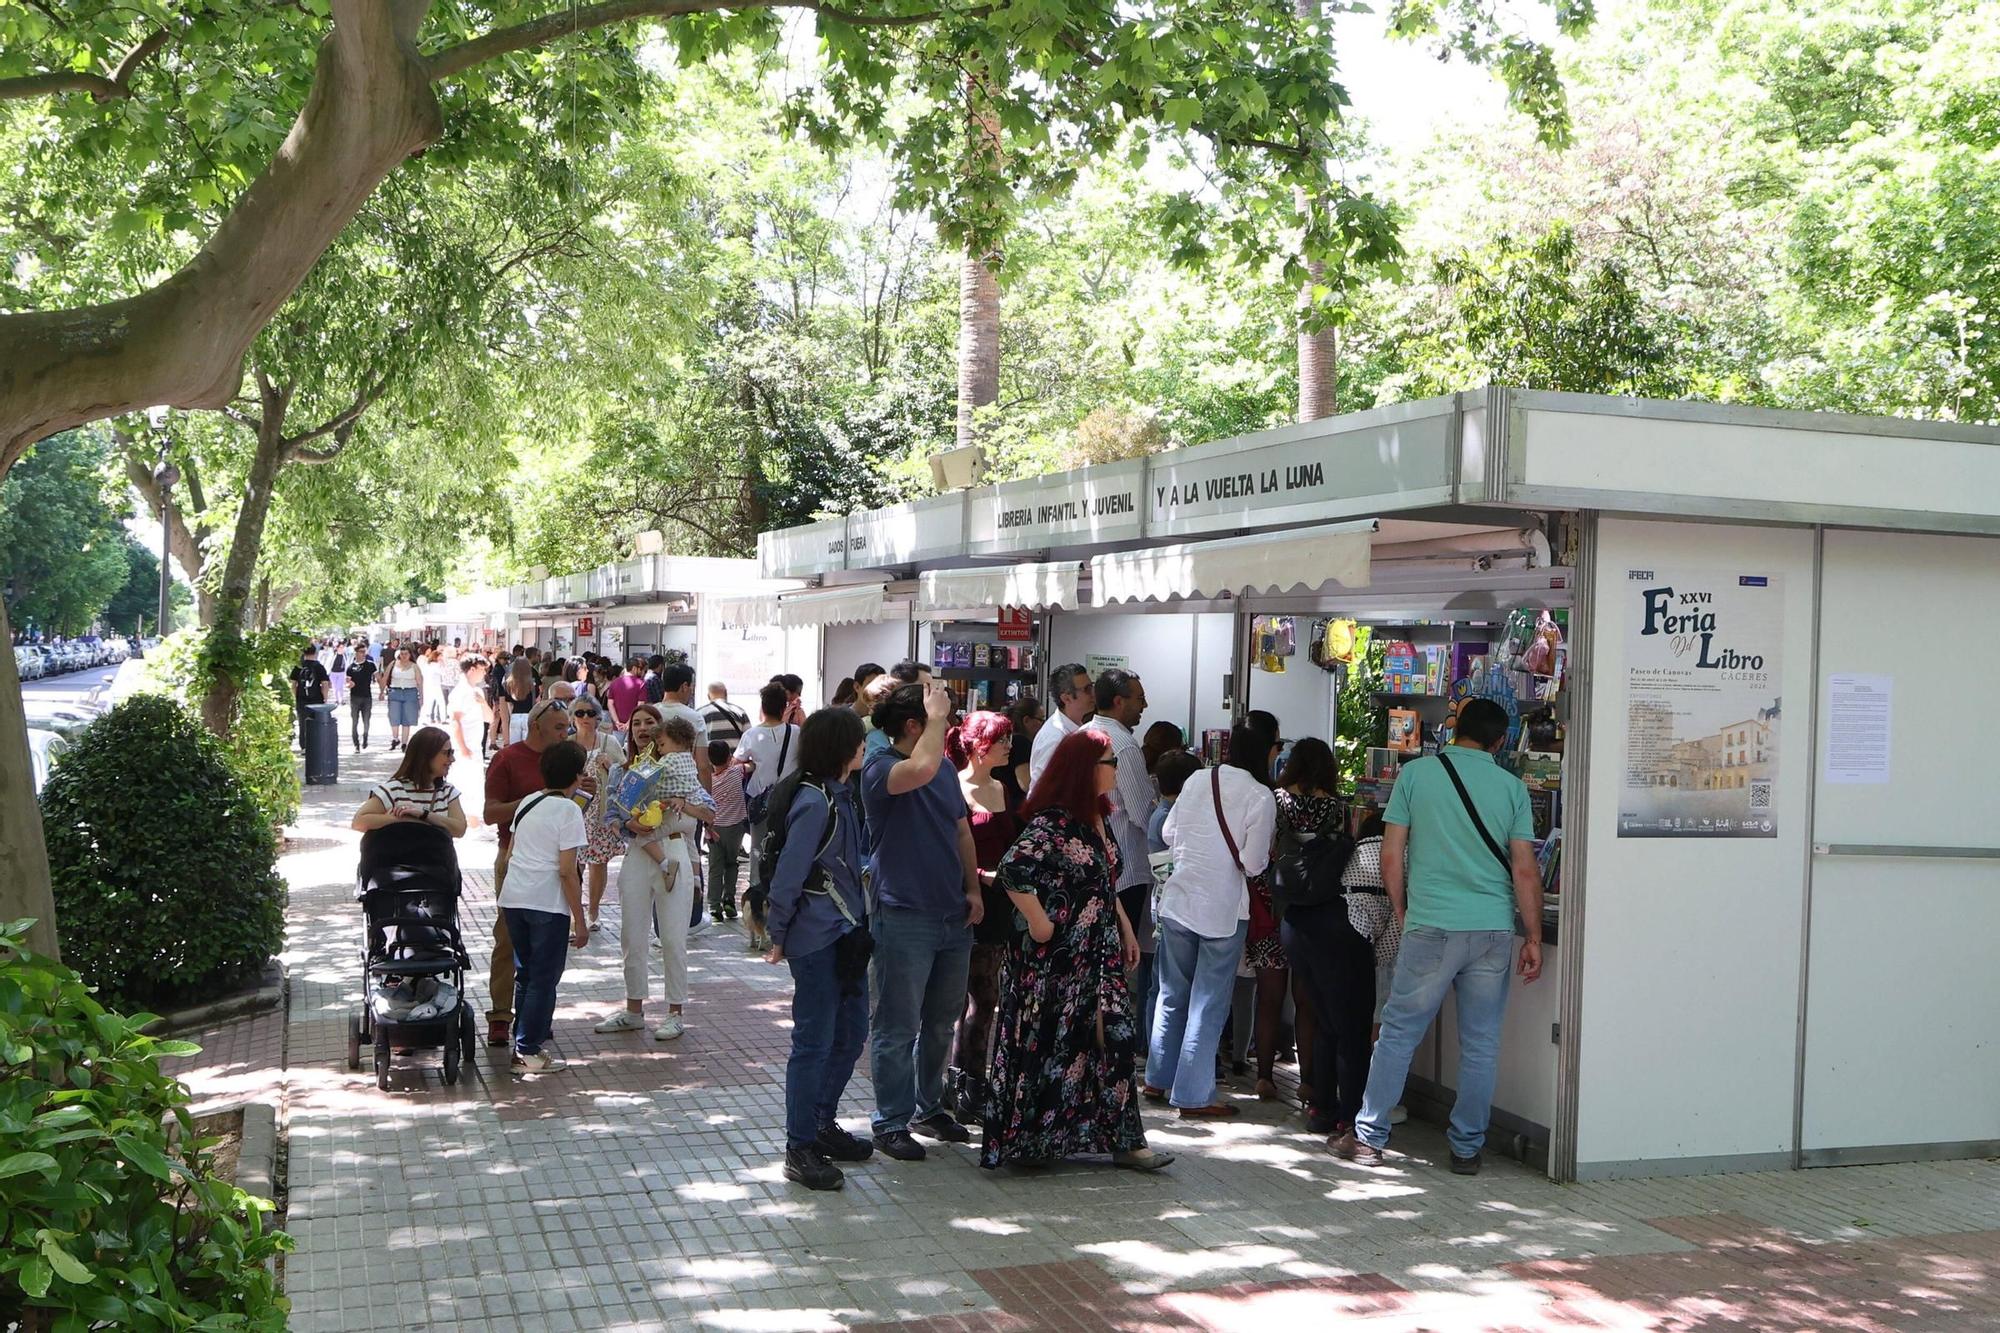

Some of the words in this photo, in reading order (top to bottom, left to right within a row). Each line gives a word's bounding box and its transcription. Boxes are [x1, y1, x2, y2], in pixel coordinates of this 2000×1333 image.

[1157, 486, 1165, 508] Y
[1170, 485, 1179, 506] A
[1184, 482, 1199, 504] LA
[1205, 473, 1254, 501] VUELTA
[1260, 469, 1278, 494] LA
[1286, 462, 1324, 490] LUNA
[1037, 501, 1078, 524] INFANTIL
[1081, 499, 1088, 518] Y
[1091, 492, 1134, 516] JUVENIL
[850, 535, 867, 551] FUERA
[1680, 592, 1712, 605] XXVI
[1641, 587, 1716, 635] Feria
[999, 629, 1029, 637] EXTINTOR
[1695, 632, 1764, 671] Libro
[1630, 667, 1651, 675] Paseo
[1652, 668, 1661, 676] de
